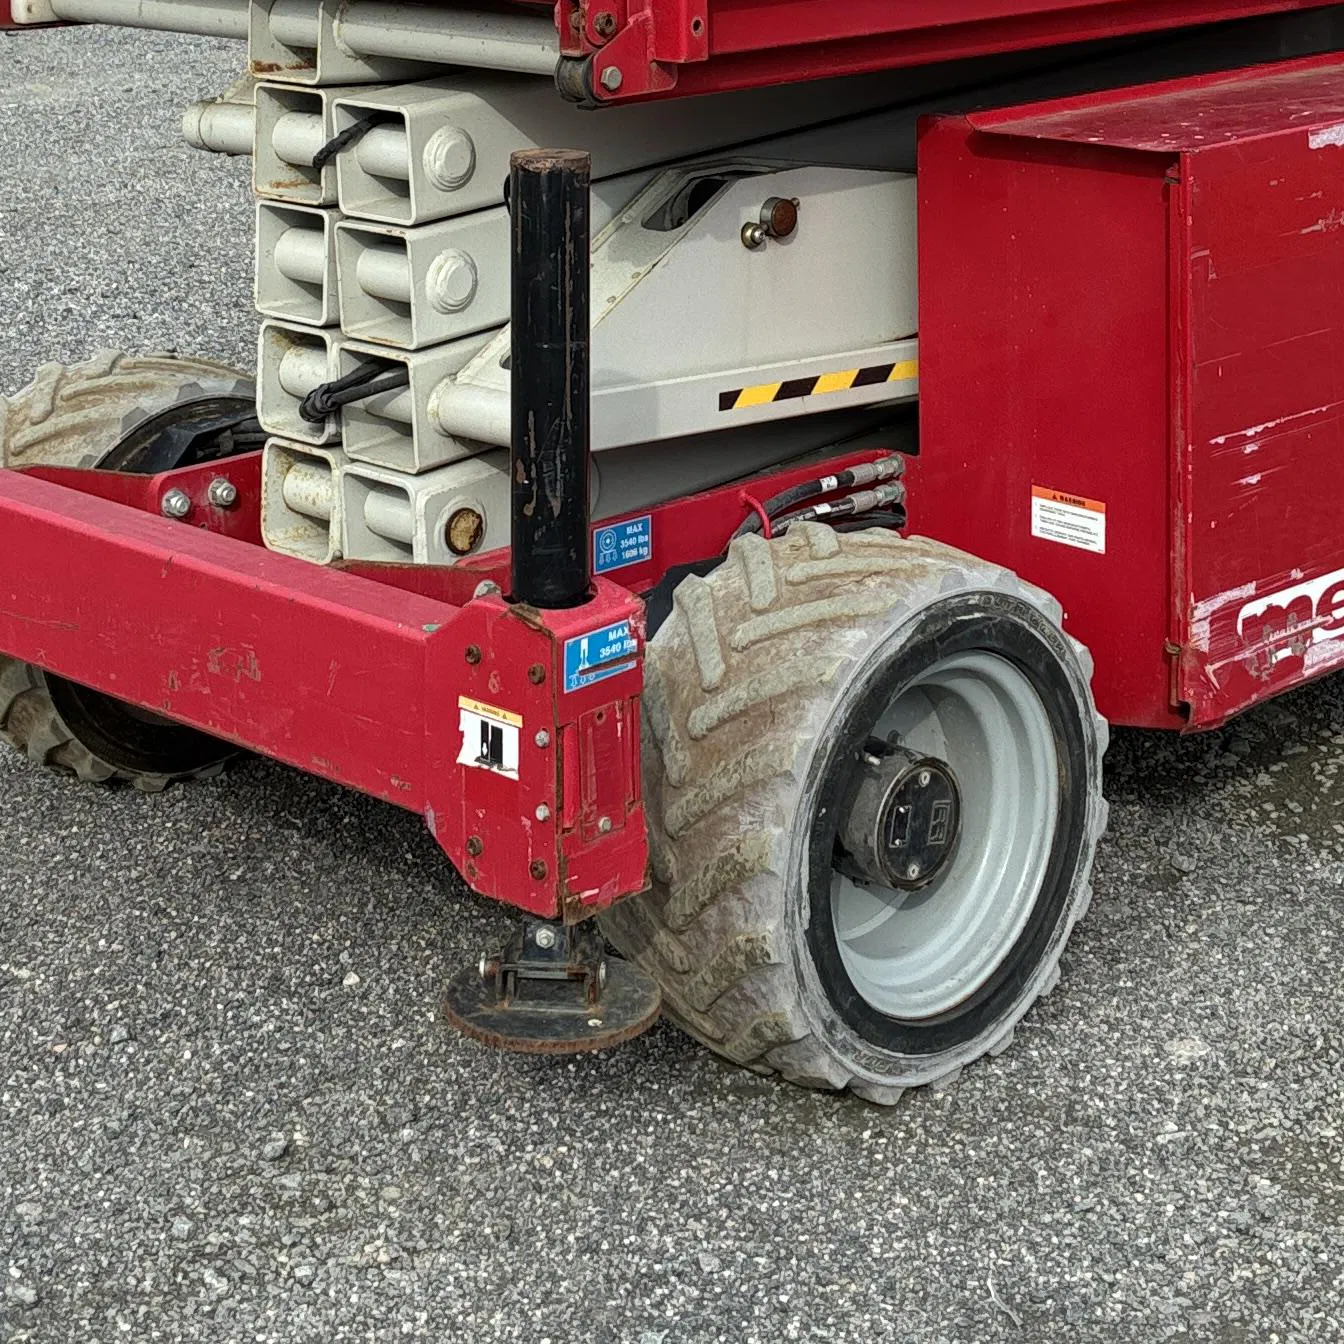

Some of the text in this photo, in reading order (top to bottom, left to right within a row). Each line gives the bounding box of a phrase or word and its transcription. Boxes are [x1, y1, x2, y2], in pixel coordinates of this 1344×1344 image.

[626, 523, 642, 534] MAX
[620, 537, 636, 548] 3540
[608, 626, 628, 641] MAX
[599, 641, 621, 658] 3540
